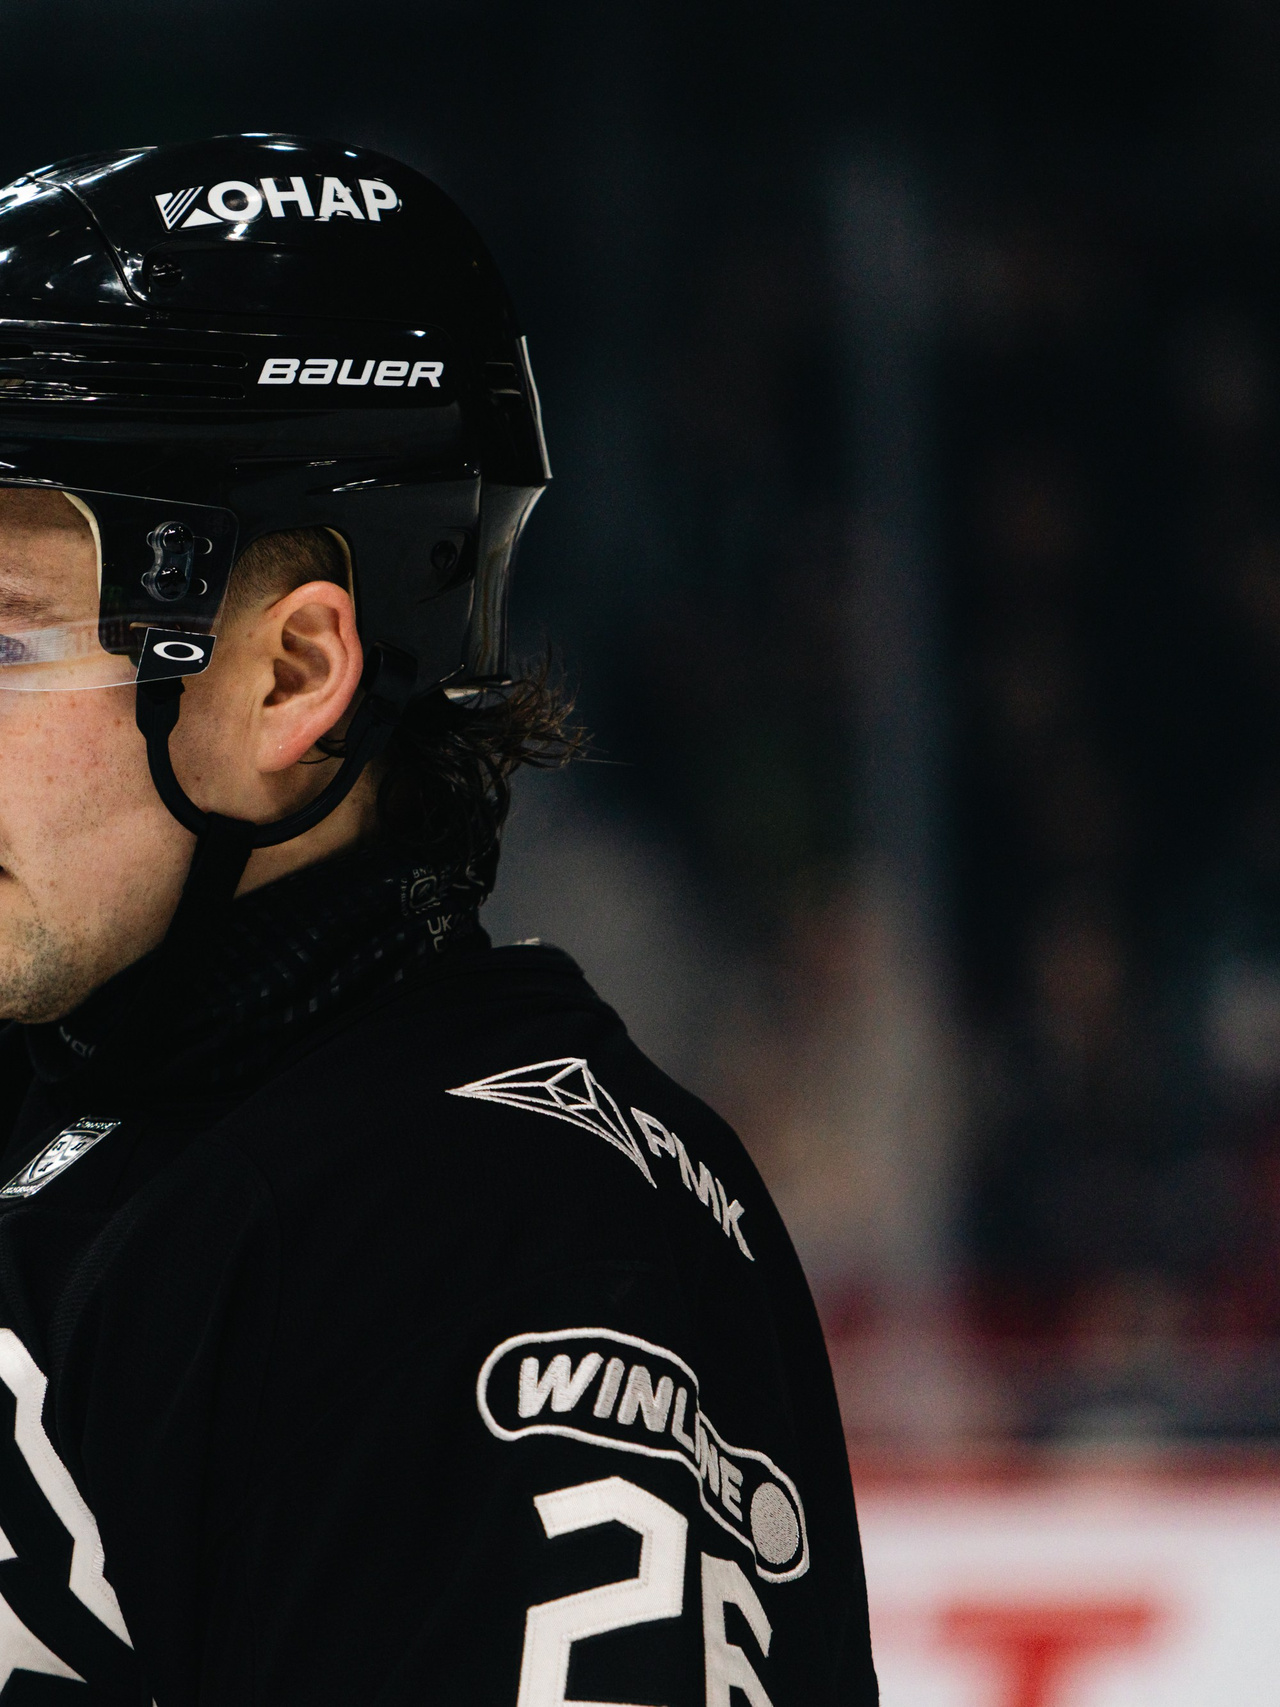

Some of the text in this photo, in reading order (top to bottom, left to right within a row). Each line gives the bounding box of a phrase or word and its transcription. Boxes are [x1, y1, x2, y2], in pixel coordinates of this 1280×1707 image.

[256, 357, 445, 388] BAUER
[517, 1352, 745, 1522] WINLINE
[516, 1474, 776, 1707] 26
